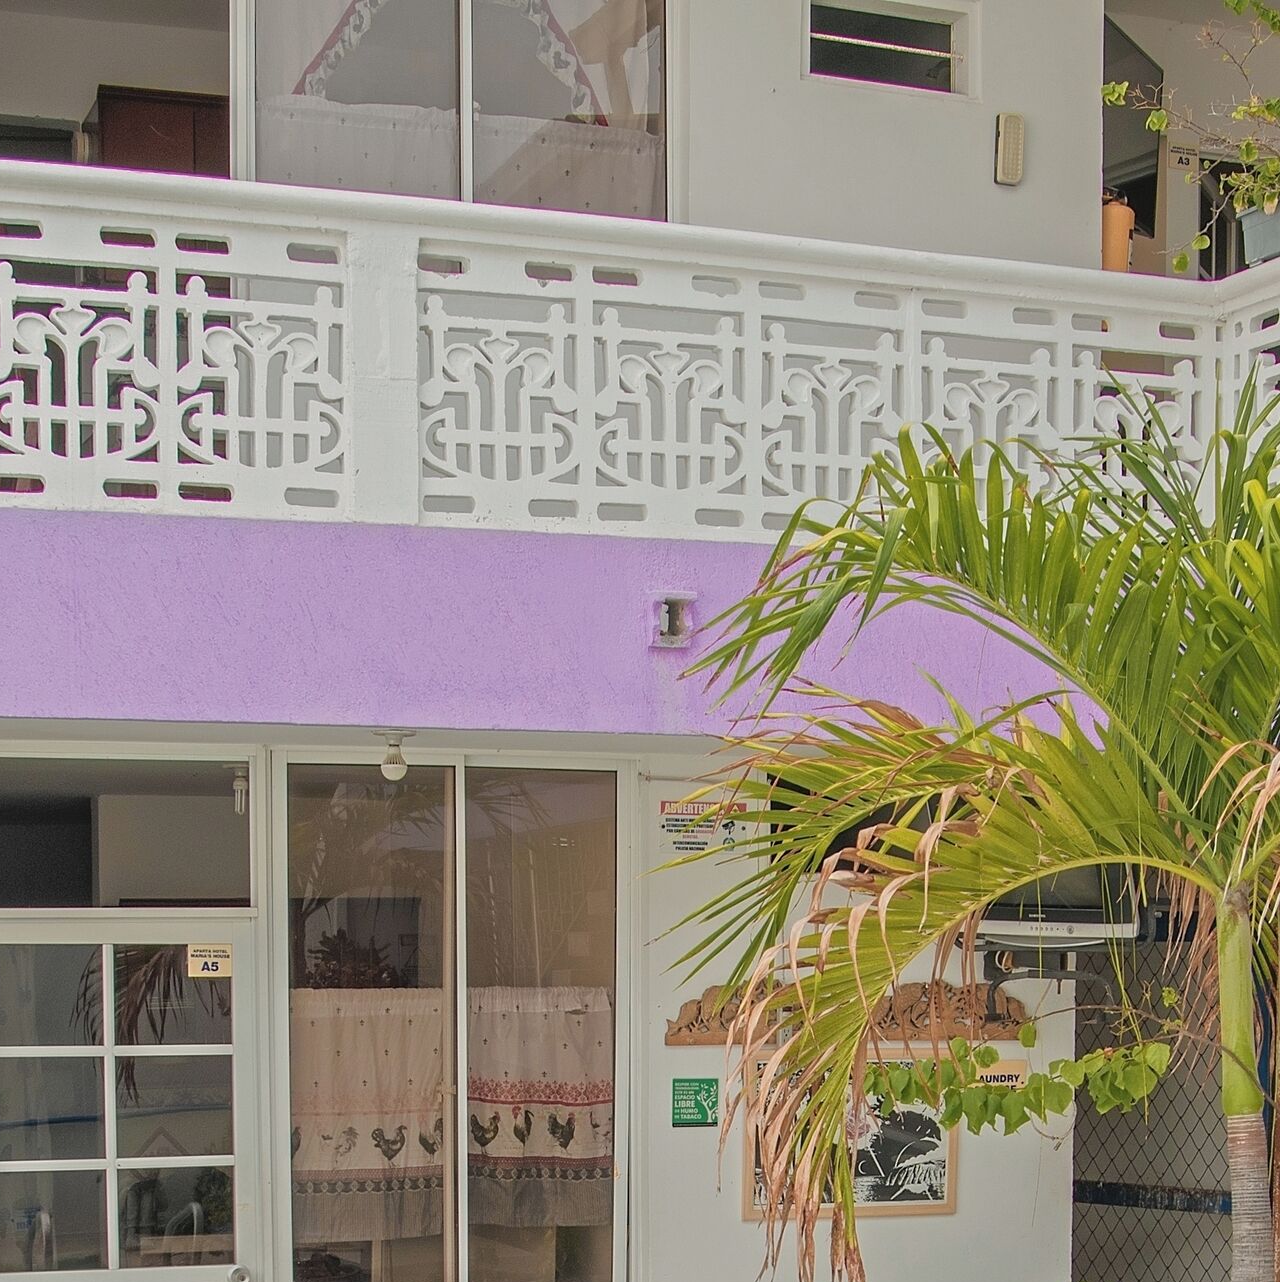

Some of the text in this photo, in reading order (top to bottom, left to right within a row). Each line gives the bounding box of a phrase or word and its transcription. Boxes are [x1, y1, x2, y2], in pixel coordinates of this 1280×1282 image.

[1177, 156, 1190, 165] A3
[201, 961, 219, 971] A5
[980, 1075, 1020, 1083] AUNDRY
[674, 1100, 696, 1108] LIBRE
